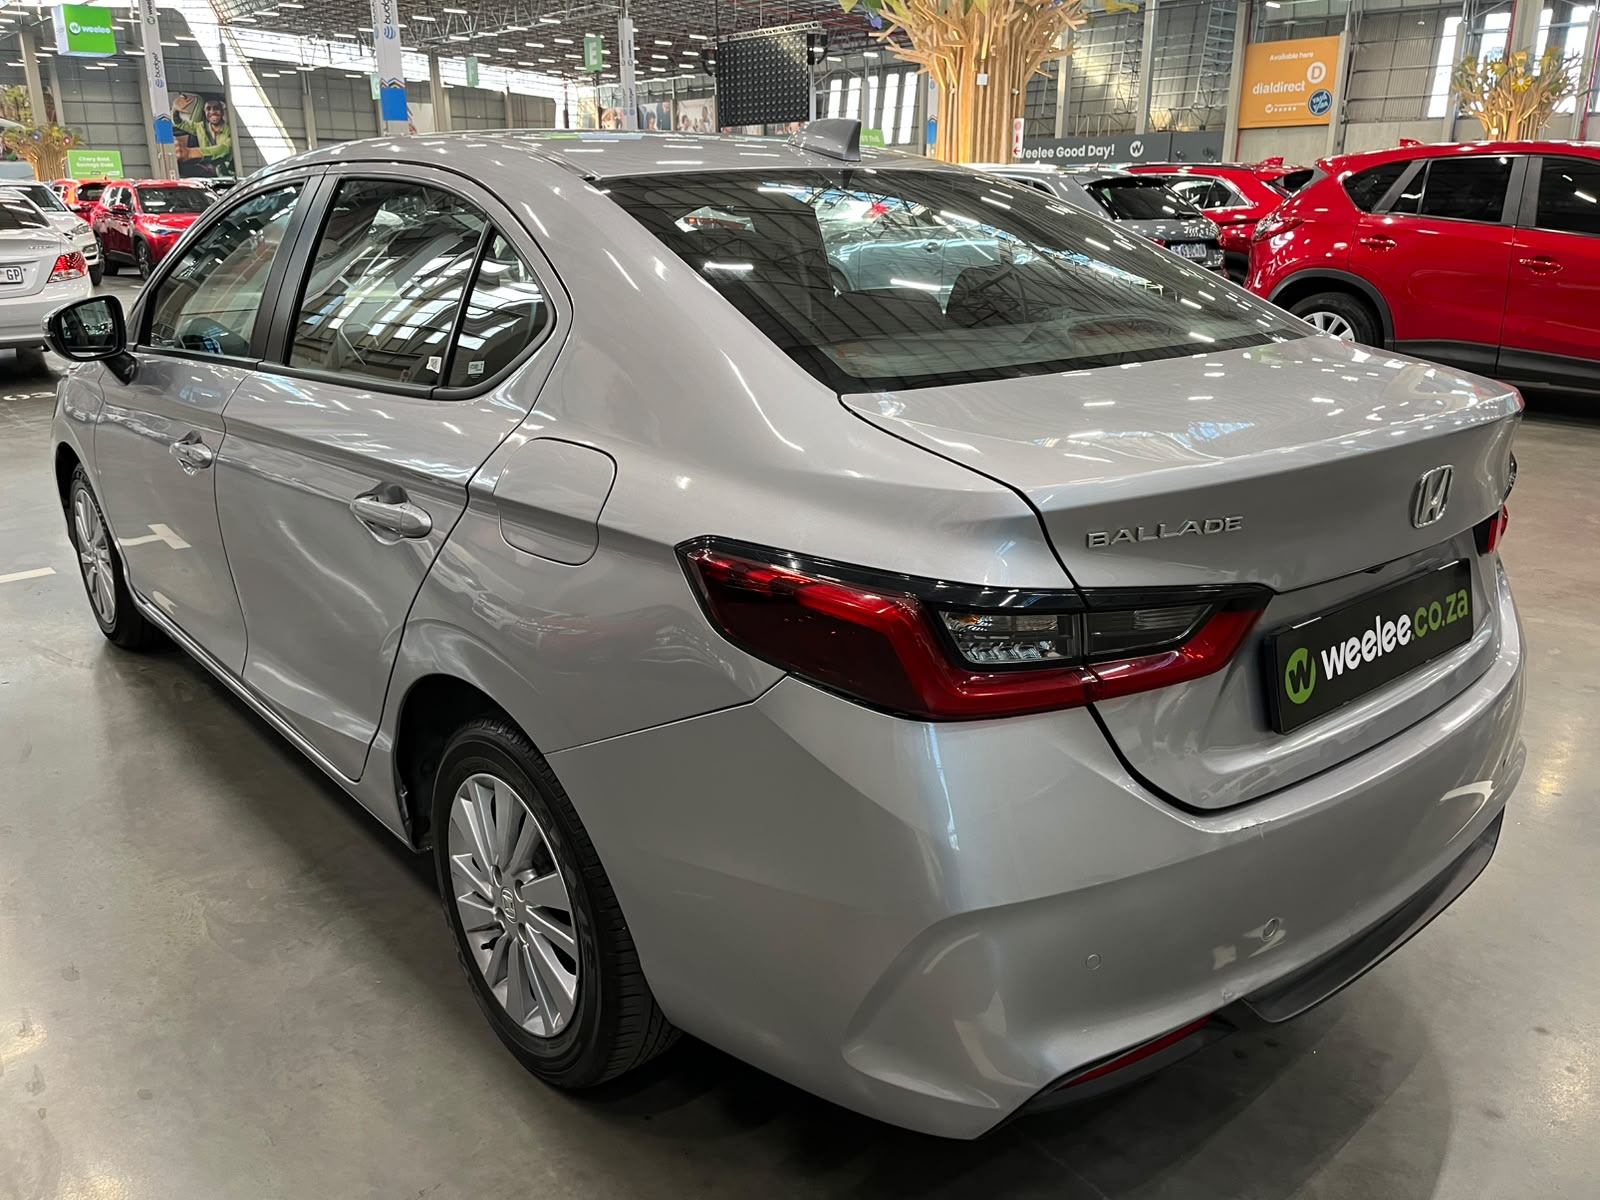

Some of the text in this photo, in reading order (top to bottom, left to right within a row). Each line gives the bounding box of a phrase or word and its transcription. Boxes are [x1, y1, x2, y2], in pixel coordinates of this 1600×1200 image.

[82, 26, 111, 34] weelee
[588, 42, 597, 66] E
[1269, 53, 1298, 61] Available
[154, 52, 163, 78] budget
[1252, 80, 1306, 95] dialdirect
[1021, 147, 1055, 158] eelee
[1056, 145, 1086, 157] Good
[1087, 144, 1115, 159] Day!
[6, 269, 20, 280] GP
[1086, 515, 1244, 549] BALLADE
[1321, 588, 1469, 681] weelee.co.za
